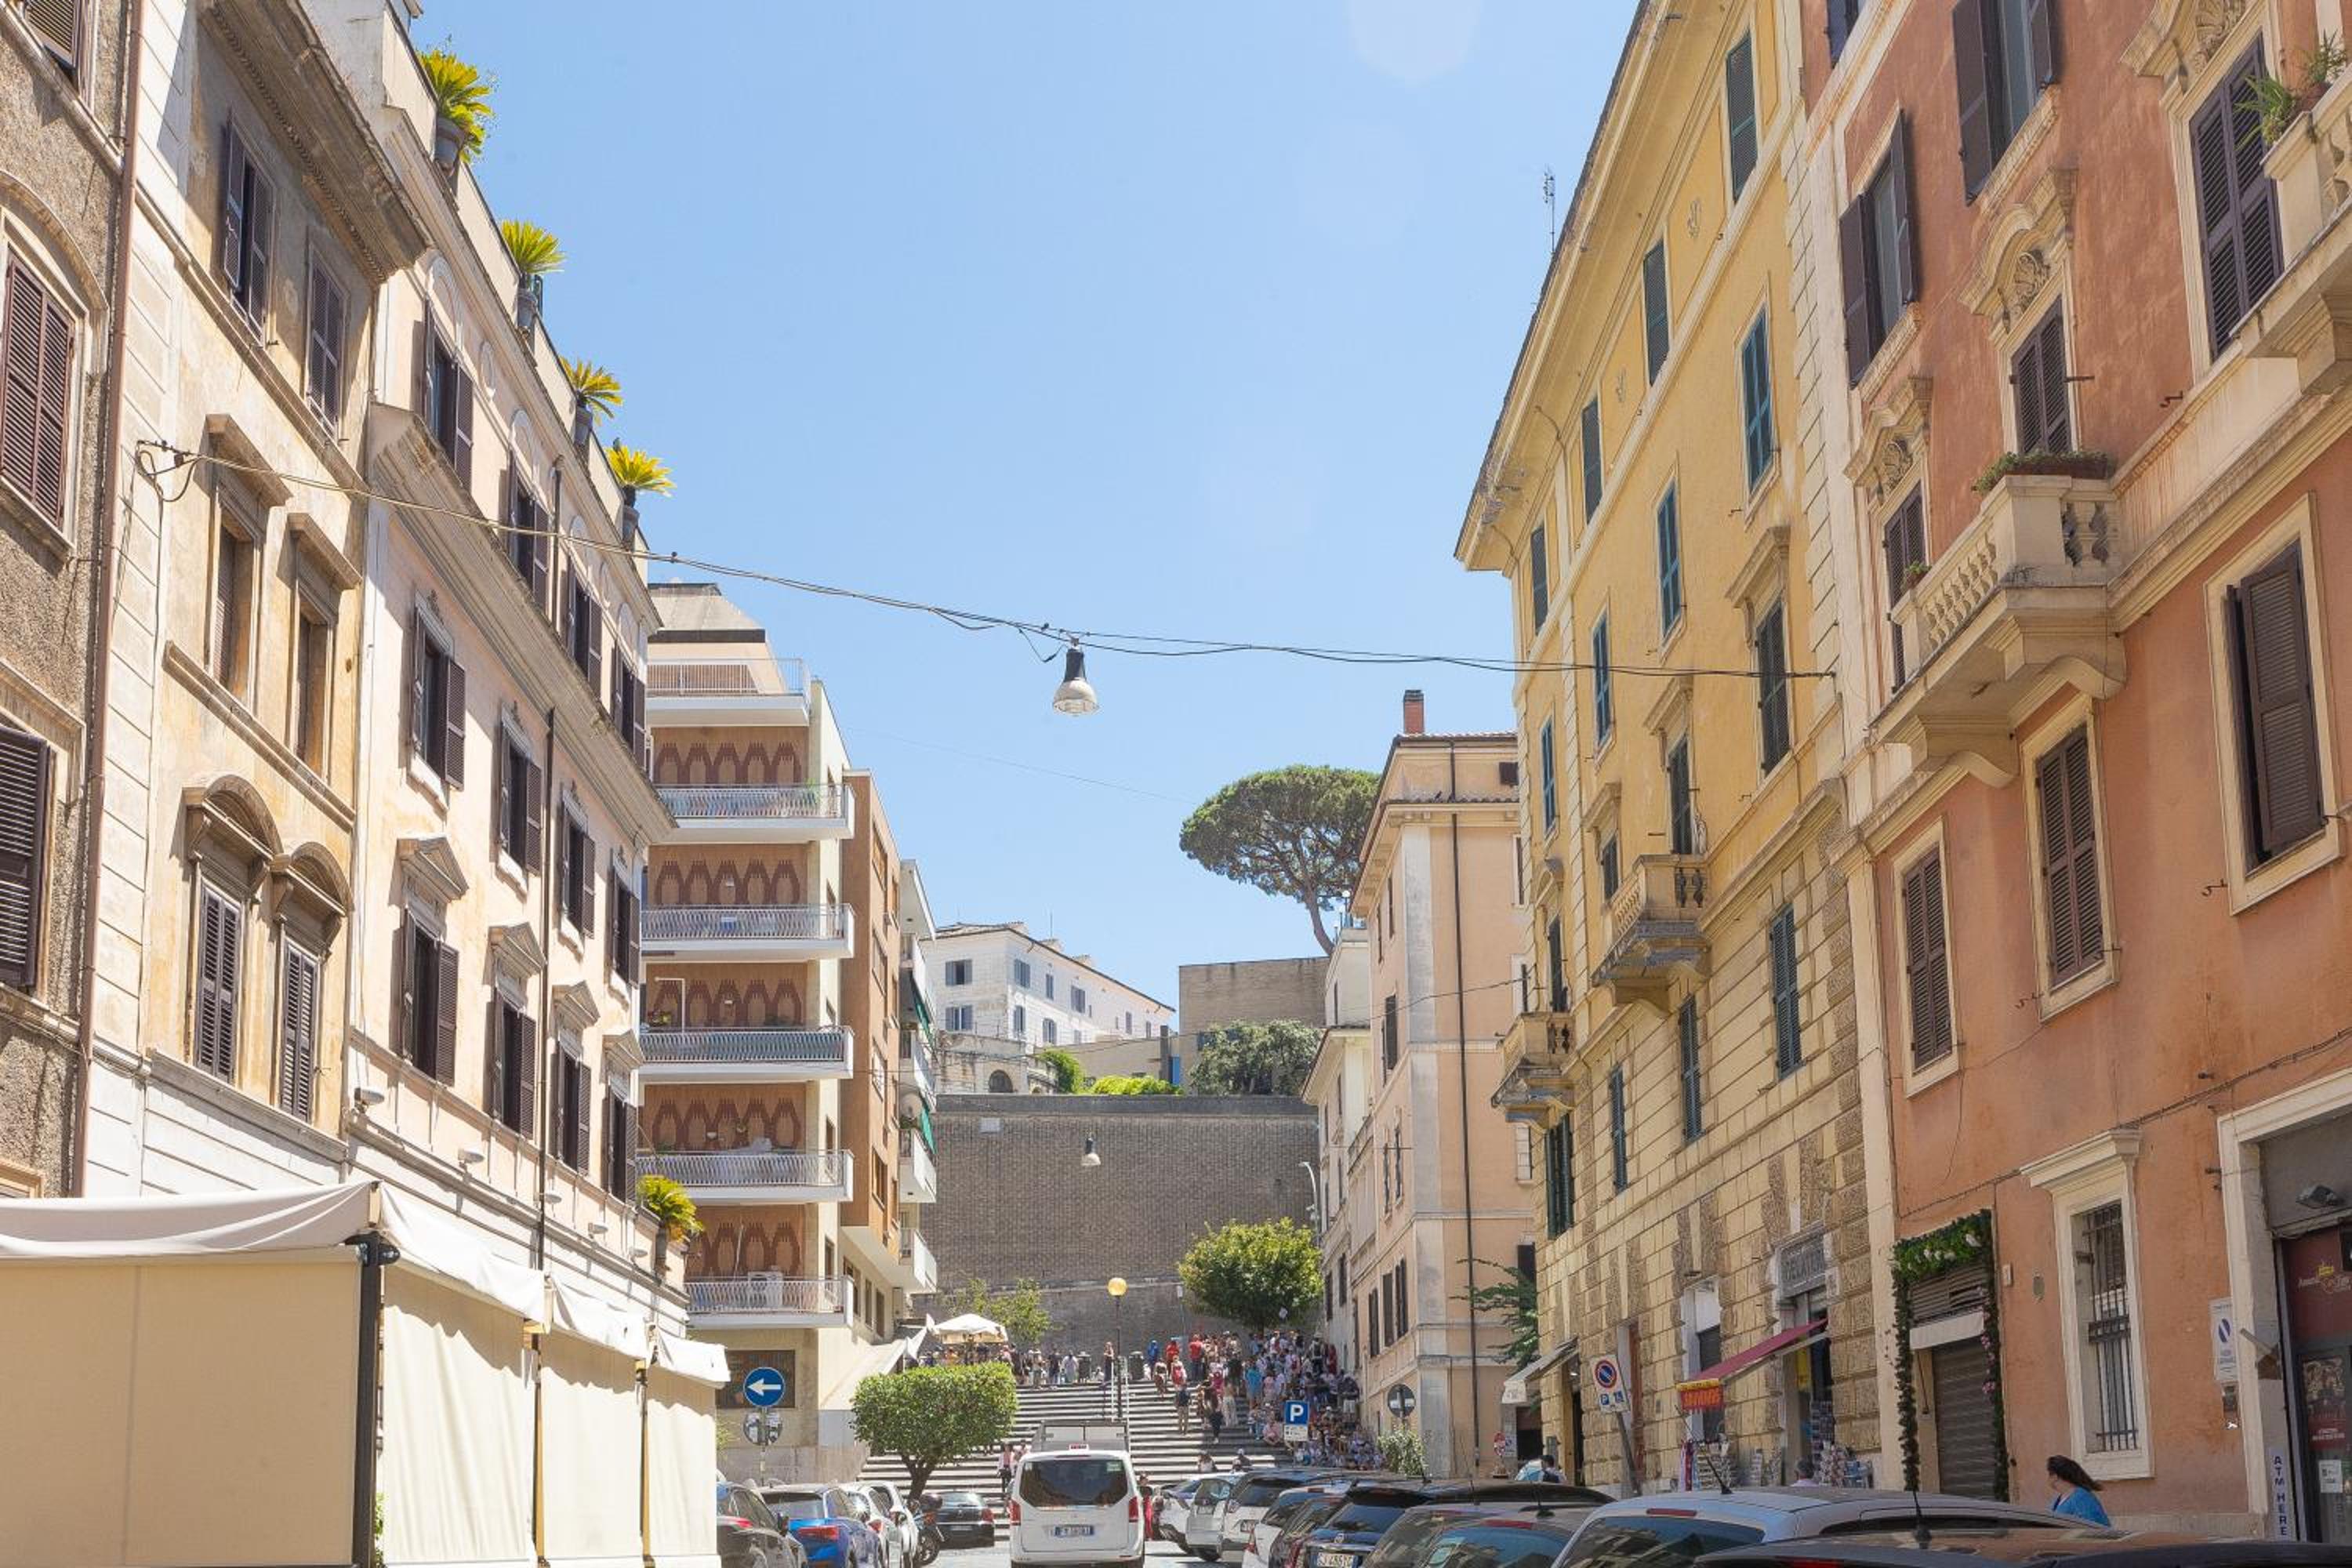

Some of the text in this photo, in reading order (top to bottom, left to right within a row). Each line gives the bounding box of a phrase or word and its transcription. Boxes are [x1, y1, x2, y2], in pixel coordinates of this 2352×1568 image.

[1290, 1404, 1304, 1422] P
[2274, 1456, 2287, 1536] ATM HERE
